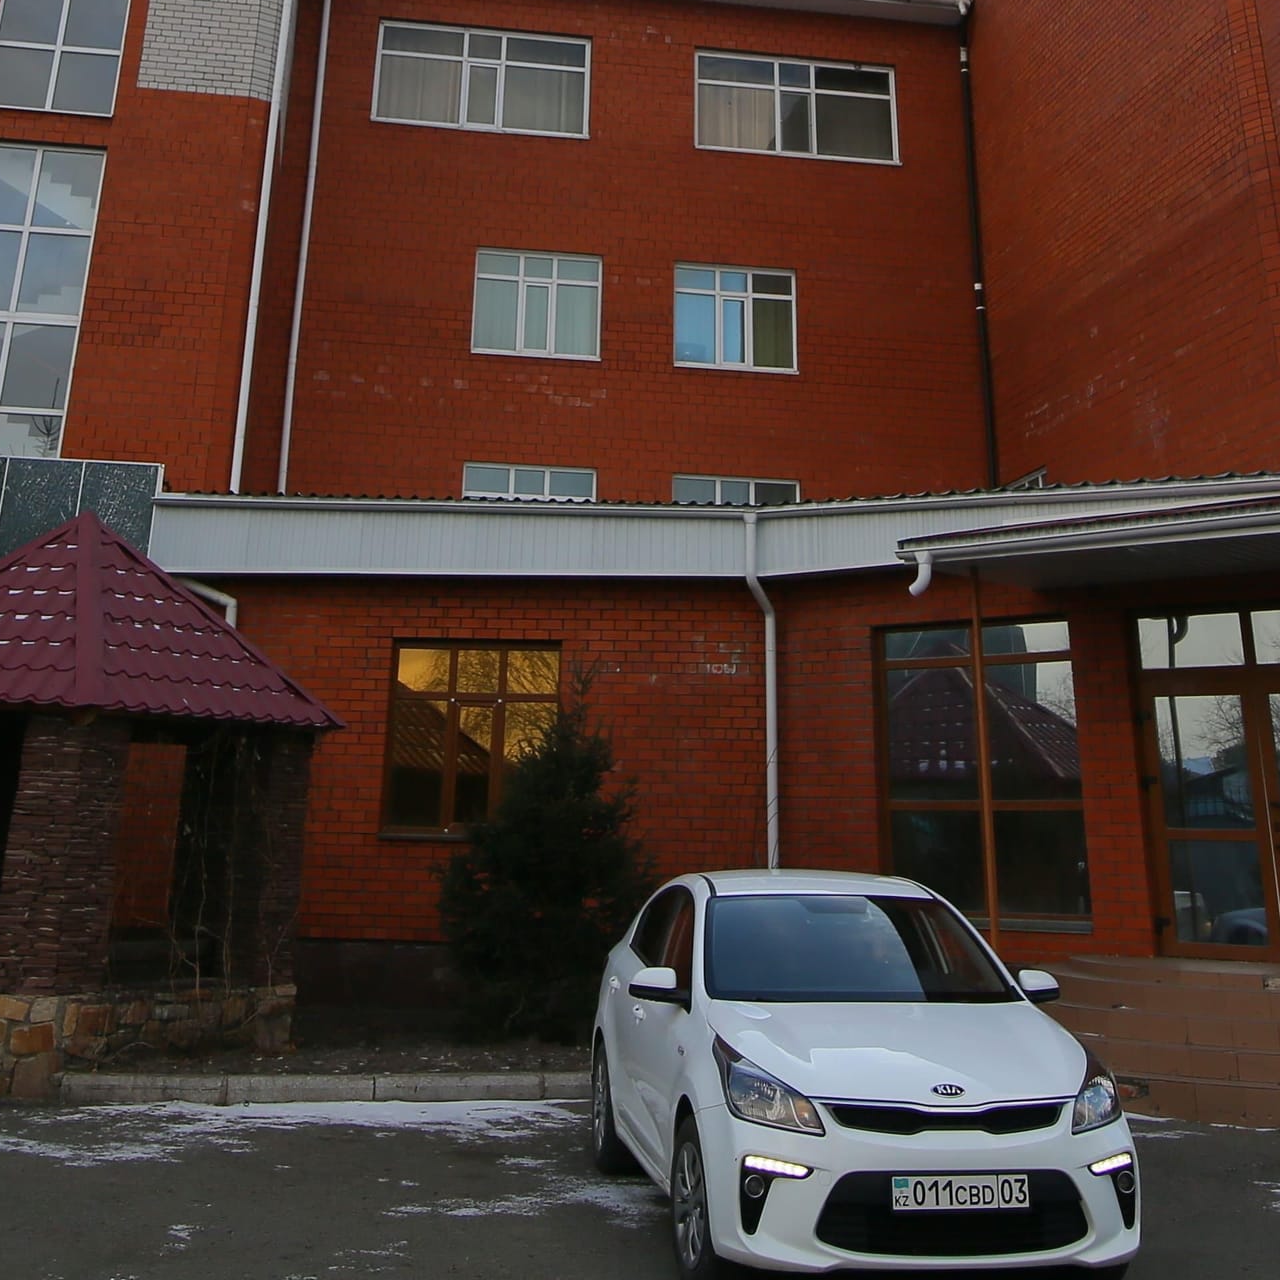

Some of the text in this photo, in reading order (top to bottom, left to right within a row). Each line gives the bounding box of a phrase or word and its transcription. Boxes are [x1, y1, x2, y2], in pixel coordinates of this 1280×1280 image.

[935, 1084, 963, 1095] KIA
[1000, 1178, 1027, 1205] 03
[894, 1195, 910, 1207] KZ
